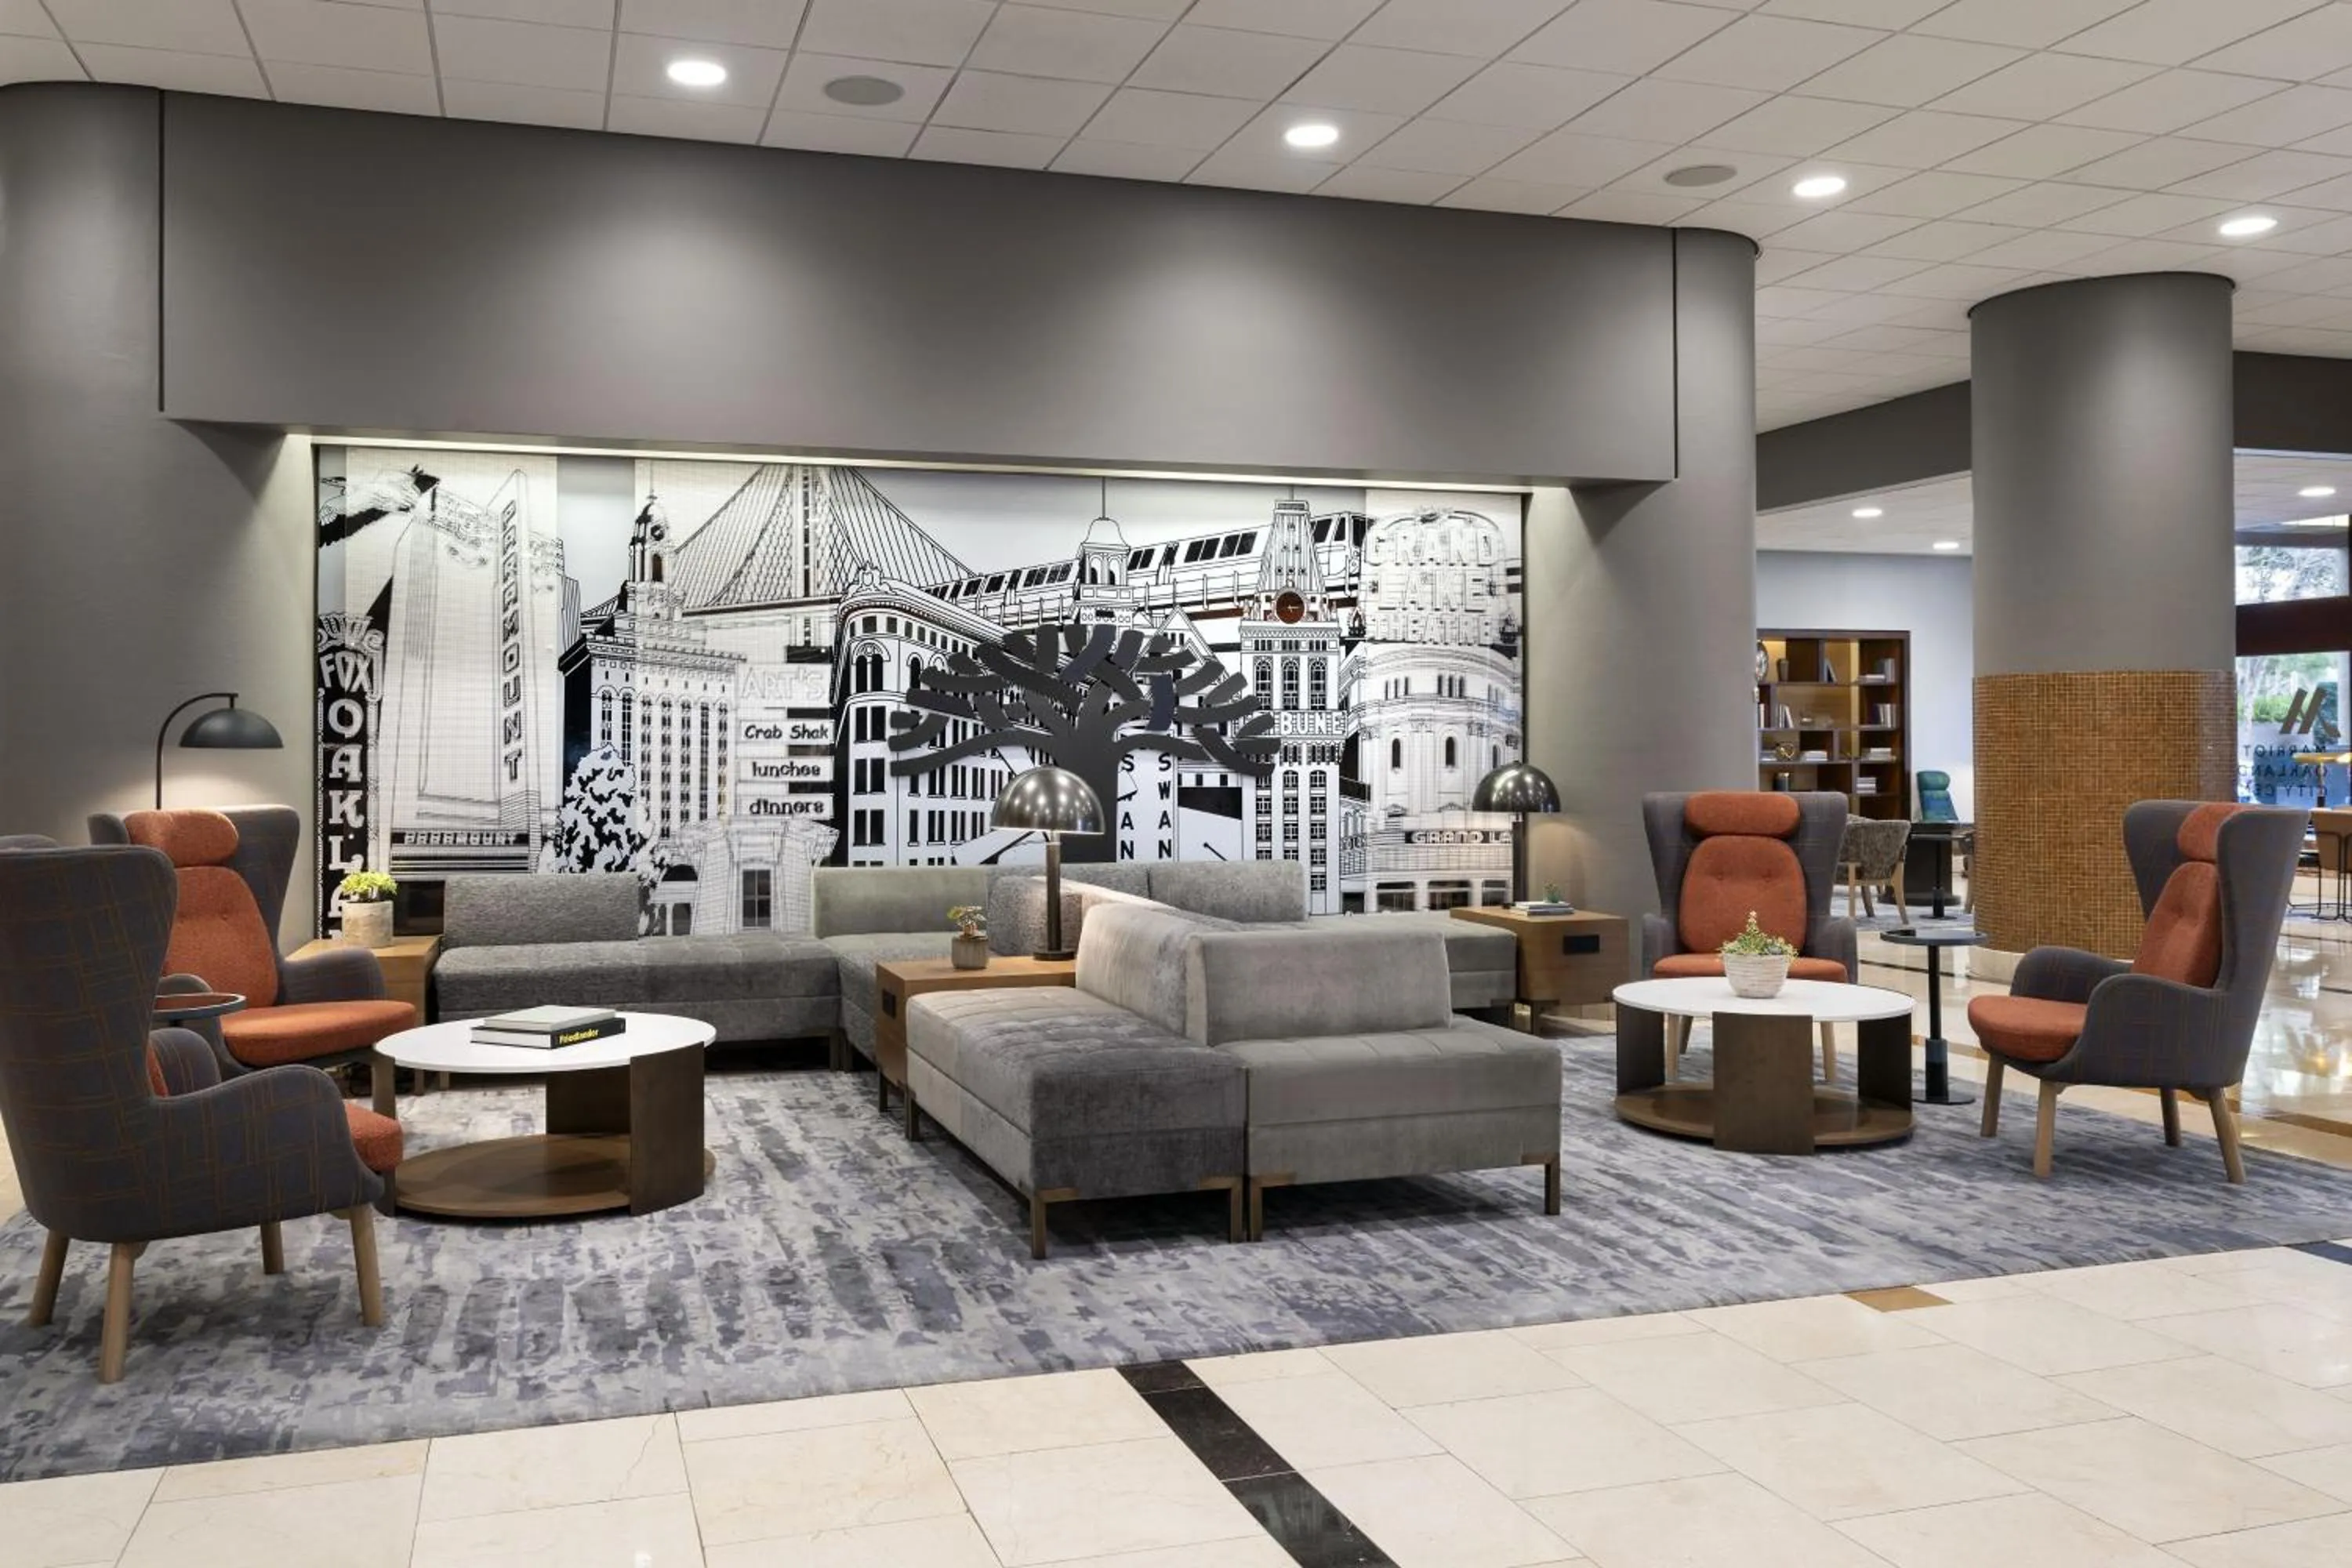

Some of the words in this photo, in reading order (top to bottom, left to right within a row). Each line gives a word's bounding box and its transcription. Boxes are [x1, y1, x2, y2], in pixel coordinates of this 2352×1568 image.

[1377, 568, 1487, 613] LAKE
[501, 499, 521, 782] PARAMOUNT
[319, 652, 372, 692] FOX
[741, 666, 825, 700] ART'S
[745, 724, 782, 739] Crab
[789, 724, 829, 739] Shak
[752, 760, 822, 779] lunches
[328, 698, 365, 939] OAKL
[749, 798, 825, 815] dinners
[1158, 752, 1172, 859] SWAN
[404, 831, 516, 846] PARAMOUNT
[1412, 830, 1483, 844] GRAND
